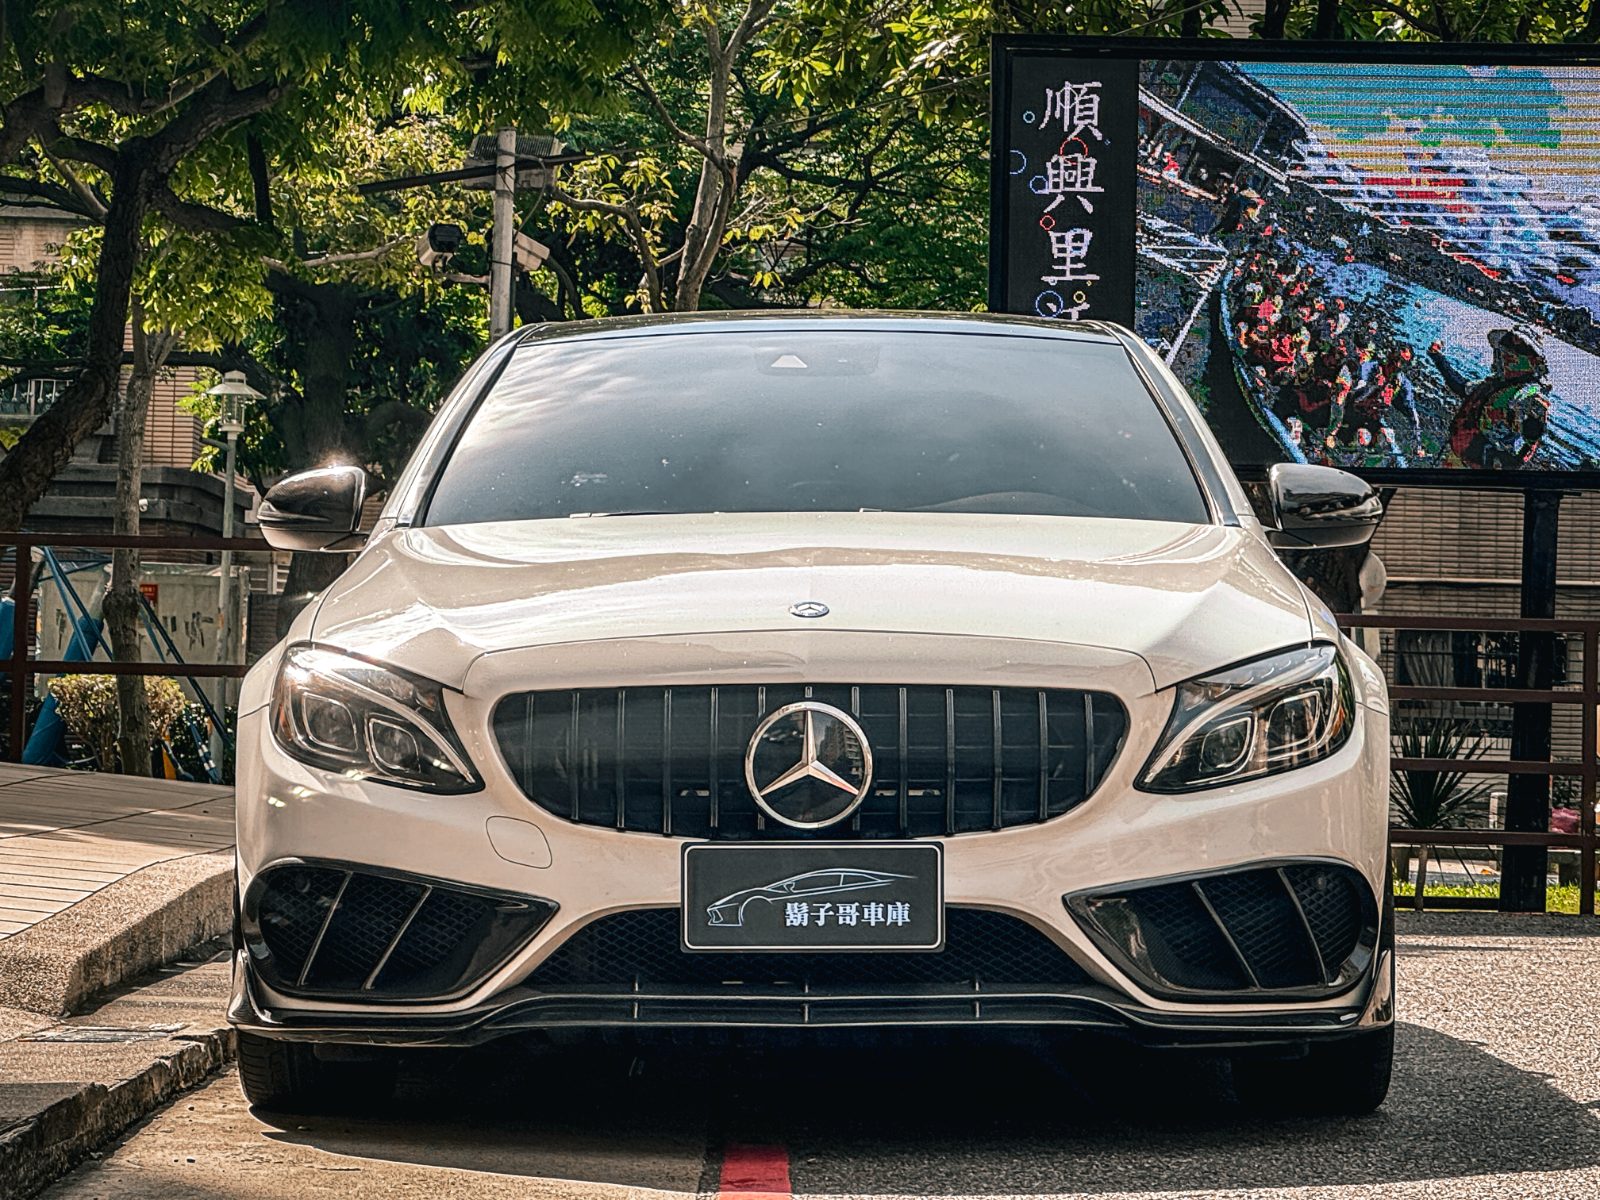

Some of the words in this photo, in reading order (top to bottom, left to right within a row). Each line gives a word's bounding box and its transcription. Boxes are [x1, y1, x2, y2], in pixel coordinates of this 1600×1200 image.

[784, 901, 911, 927] 鬍子哥車庫
